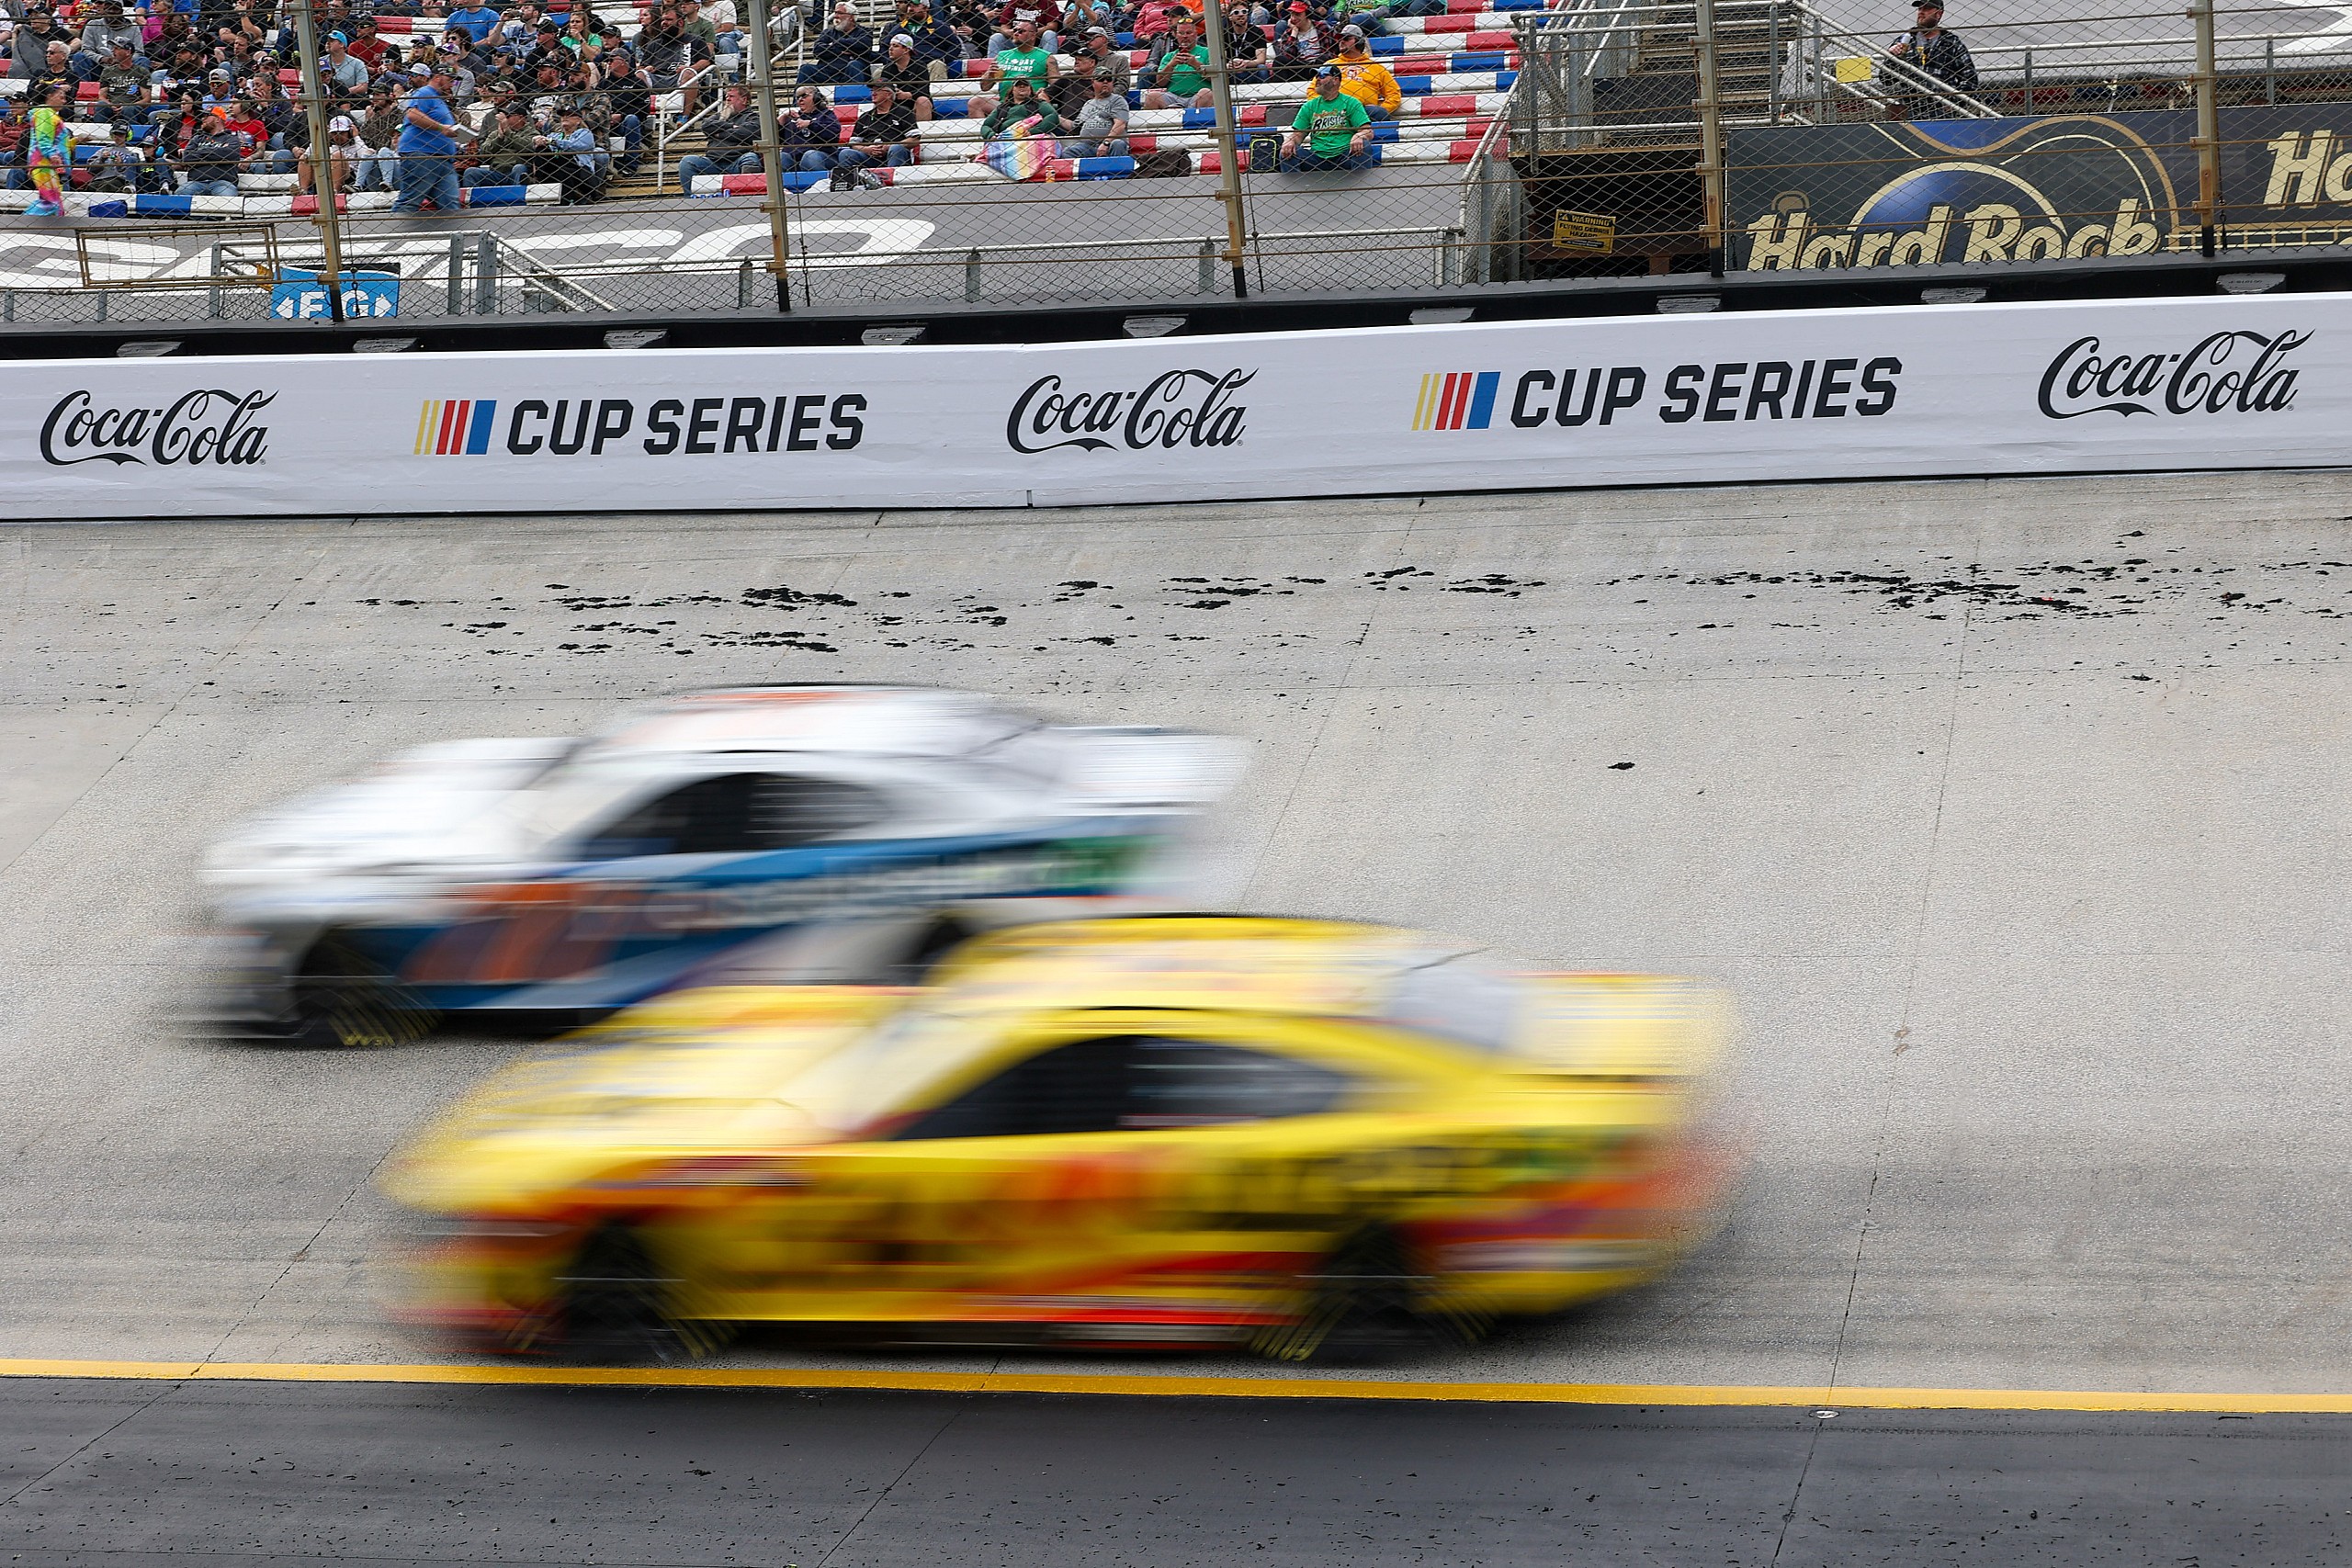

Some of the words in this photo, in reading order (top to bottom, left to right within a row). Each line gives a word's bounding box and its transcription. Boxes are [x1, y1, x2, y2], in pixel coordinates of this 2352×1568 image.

[1559, 223, 1583, 231] FLYING
[1571, 214, 1610, 227] WARNING
[1746, 204, 1952, 271] Hard
[1964, 197, 2160, 263] Rock
[1510, 367, 1646, 428] CUP
[1658, 356, 1903, 423] SERIES
[2037, 327, 2316, 419] Coca-Cola
[40, 389, 279, 466] Coca-Cola
[506, 399, 634, 456] CUP
[642, 393, 868, 456] SERIES
[1006, 367, 1260, 454] Coca-Cola
